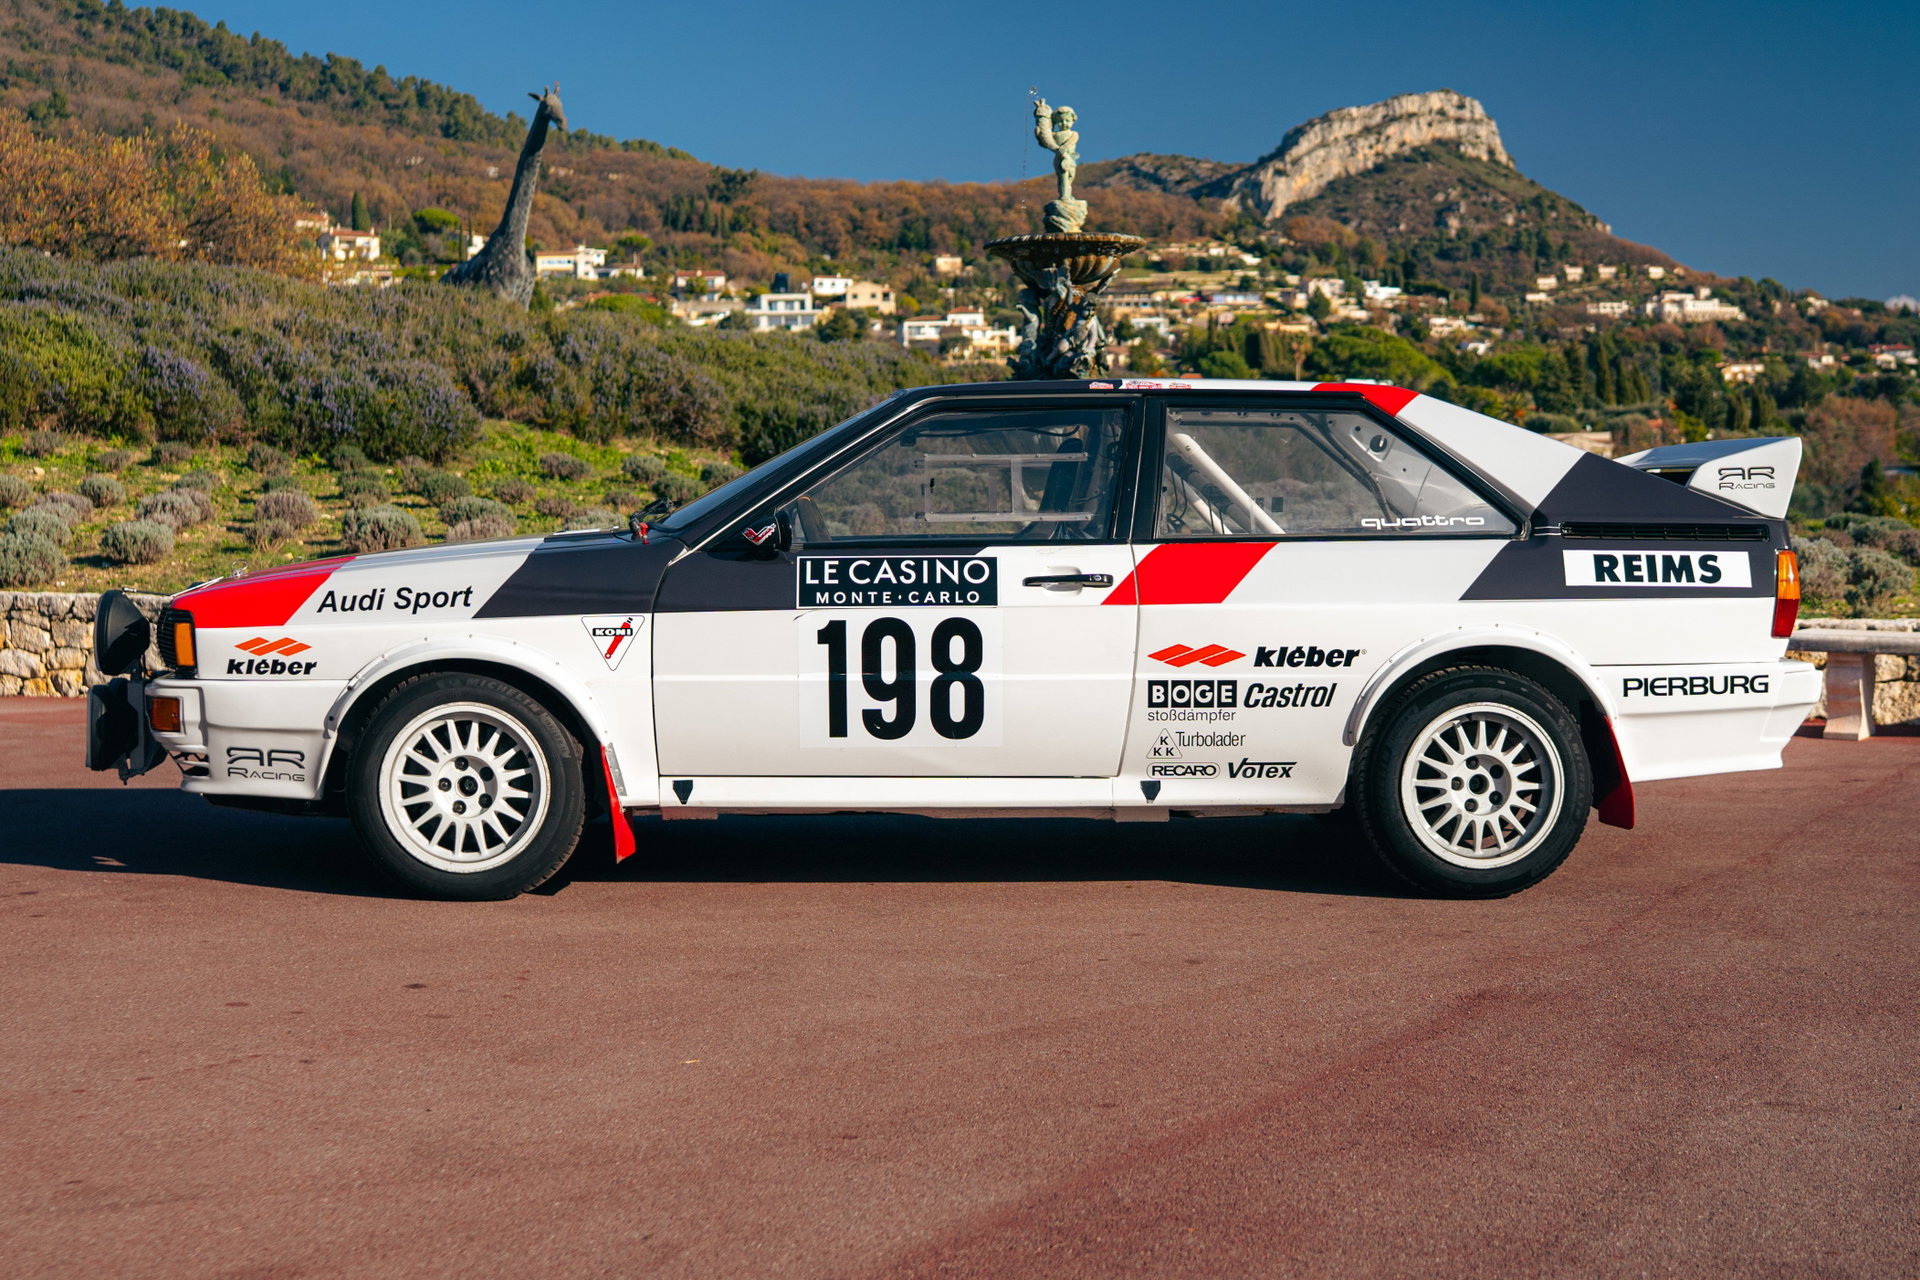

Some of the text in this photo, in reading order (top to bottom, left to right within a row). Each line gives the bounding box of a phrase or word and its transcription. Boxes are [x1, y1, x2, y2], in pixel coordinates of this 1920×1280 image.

[1361, 515, 1485, 530] quattro
[805, 559, 990, 585] LE CASINO
[1593, 553, 1722, 584] REIMS
[317, 586, 473, 614] Audi Sport
[816, 591, 980, 604] MONTE CARLO
[595, 628, 631, 636] KONI
[226, 658, 317, 675] kléber
[817, 616, 985, 740] 198
[1623, 675, 1769, 697] PIERBURG
[1152, 684, 1233, 703] BOGE
[1243, 682, 1338, 708] Castrol
[1174, 731, 1247, 747] Turbolader
[1152, 765, 1217, 776] RECARO
